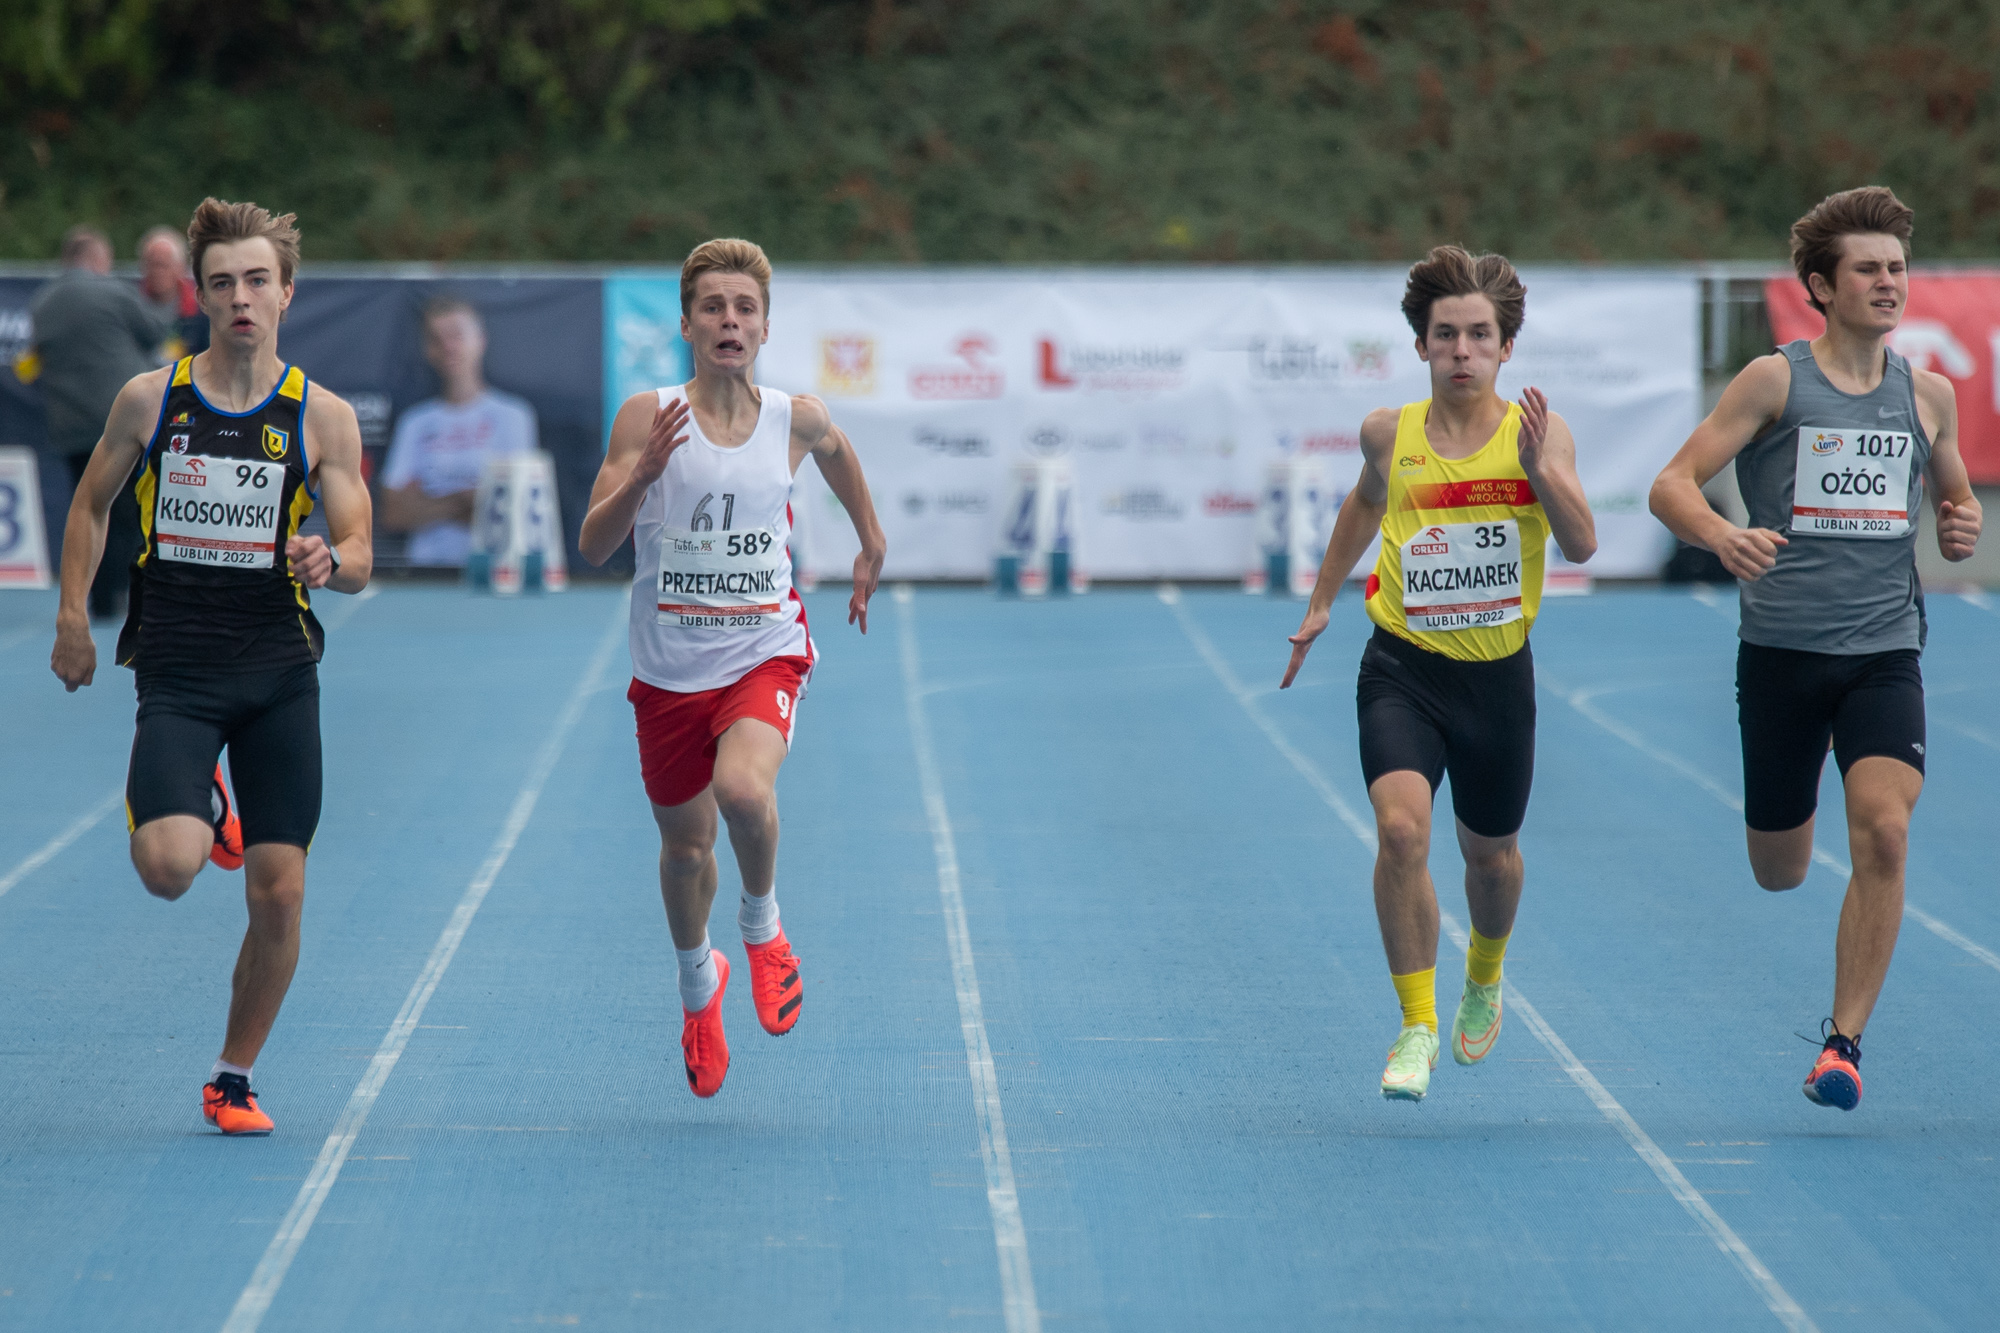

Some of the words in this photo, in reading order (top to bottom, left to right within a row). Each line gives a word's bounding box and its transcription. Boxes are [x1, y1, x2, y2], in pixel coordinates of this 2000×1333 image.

[1818, 440, 1838, 450] LOTTO
[1856, 434, 1908, 458] 1017
[1399, 455, 1426, 467] esa
[170, 473, 206, 486] ORLEN
[235, 464, 269, 489] 96
[1821, 466, 1886, 496] OŻÓG
[1471, 482, 1493, 493] MKS
[1496, 482, 1517, 493] MOS
[1466, 492, 1517, 503] WROCŁAW
[160, 496, 275, 529] KŁOSOWSKI
[690, 492, 735, 533] 61
[1814, 518, 1858, 531] LUBLIN
[1862, 520, 1891, 531] 2022
[726, 531, 772, 557] 589
[1474, 525, 1507, 549] 35
[173, 546, 218, 561] LUBLIN
[222, 551, 255, 564] 2022
[1412, 544, 1447, 555] ORLEN
[662, 569, 776, 594] PRZETACZNIK
[1407, 562, 1519, 593] KACZMAREK
[680, 615, 724, 627] LUBLIN
[729, 615, 761, 627] 2022
[1426, 614, 1470, 627] LUBLIN
[1475, 610, 1504, 624] 2022
